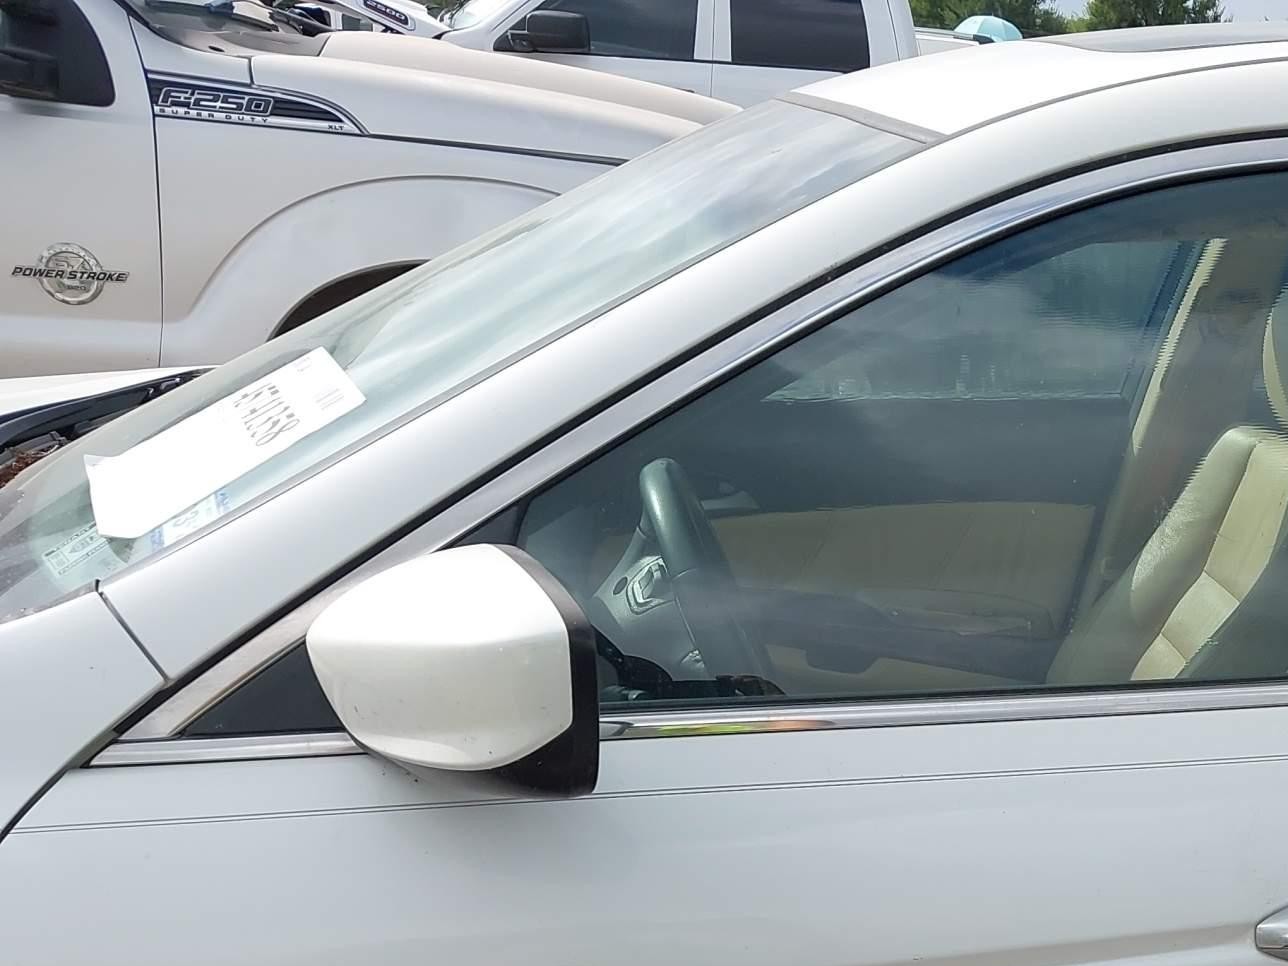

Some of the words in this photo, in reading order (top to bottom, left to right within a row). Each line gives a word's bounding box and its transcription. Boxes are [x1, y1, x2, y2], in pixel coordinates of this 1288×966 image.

[158, 87, 274, 116] F-250
[158, 107, 215, 119] SUPER
[224, 114, 269, 123] DUTY
[326, 123, 345, 131] XLT
[11, 266, 65, 279] POWER
[66, 270, 130, 282] STROKE
